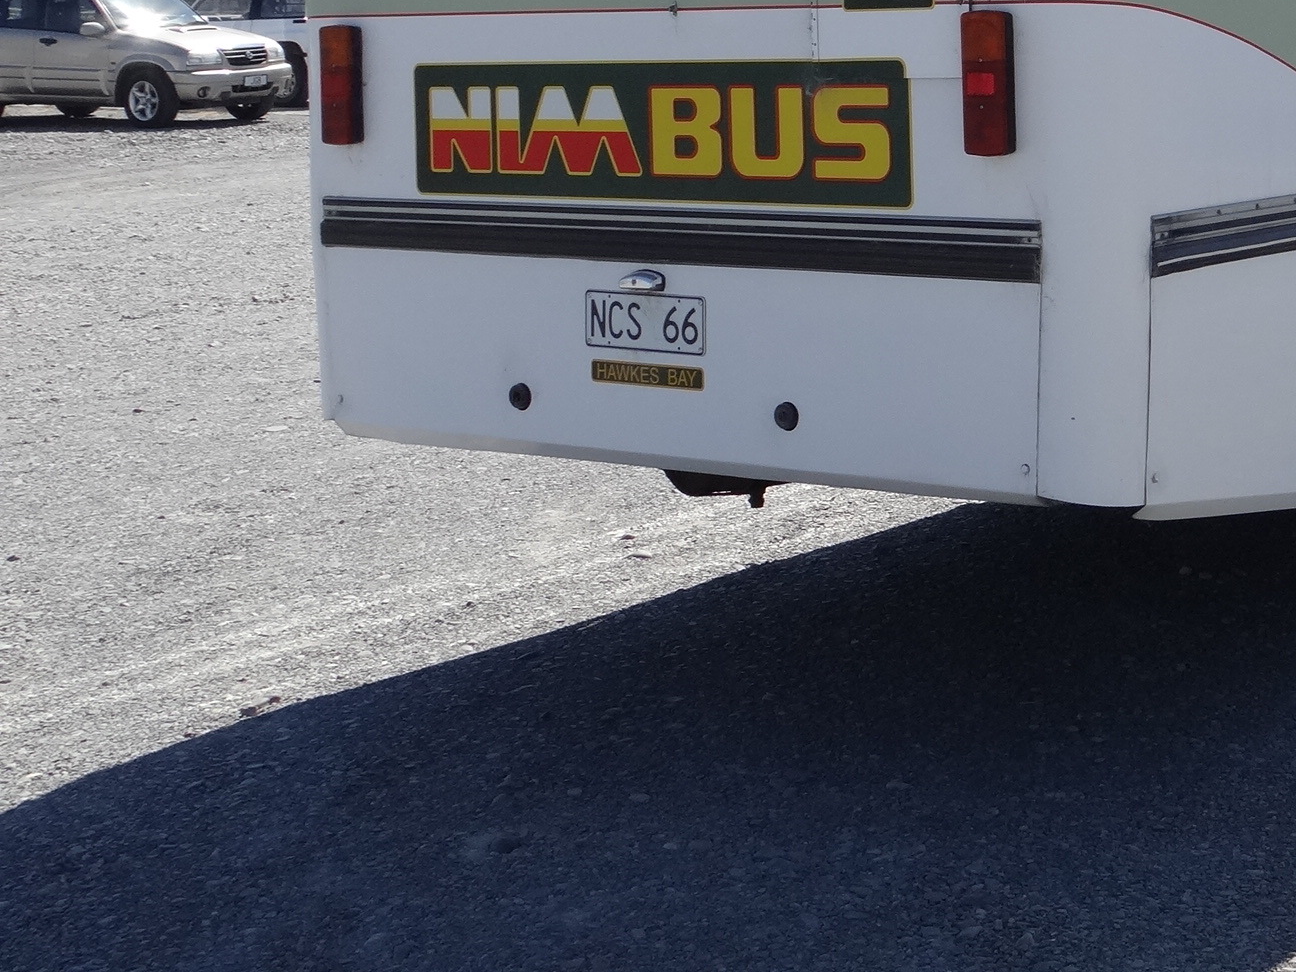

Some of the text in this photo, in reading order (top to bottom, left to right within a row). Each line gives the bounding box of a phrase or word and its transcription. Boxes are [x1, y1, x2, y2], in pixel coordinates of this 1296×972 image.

[590, 298, 699, 345] NCS 66
[596, 362, 698, 387] HAWKES BAY
